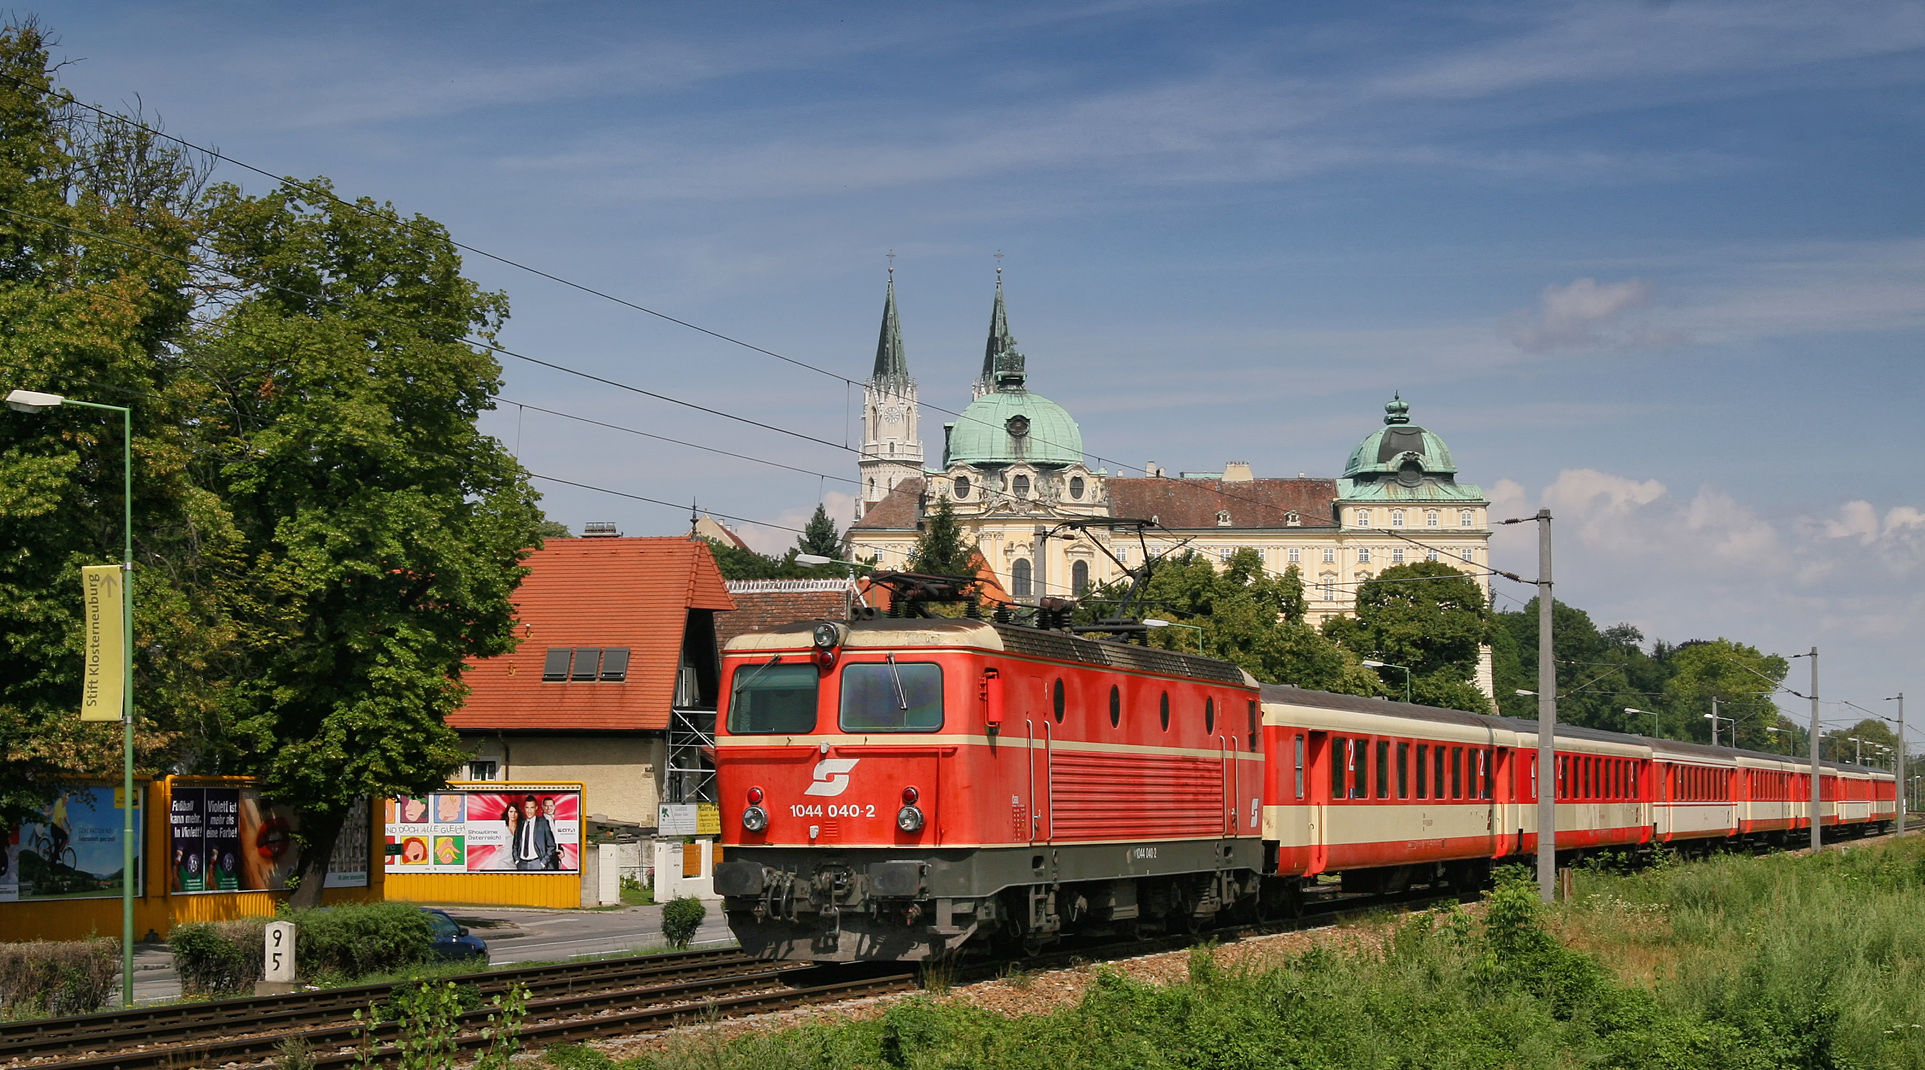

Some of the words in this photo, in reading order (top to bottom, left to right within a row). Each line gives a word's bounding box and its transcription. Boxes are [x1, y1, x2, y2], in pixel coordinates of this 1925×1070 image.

[88, 573, 100, 676] Klosterneuburg
[86, 679, 99, 707] Stift
[1348, 738, 1355, 771] 2
[1479, 749, 1484, 776] 2
[172, 800, 194, 812] Fußball
[208, 800, 228, 812] Violett
[229, 802, 237, 812] ist
[789, 804, 823, 818] 1044
[827, 804, 876, 818] 040-2
[170, 813, 184, 824] kann
[185, 812, 202, 824] mehr.
[210, 814, 225, 825] mehr
[225, 814, 235, 825] als
[181, 826, 202, 838] Violett!
[206, 827, 218, 838] eine
[219, 826, 238, 838] Farbe!
[398, 824, 419, 835] DOCH
[421, 825, 439, 834] ALLE
[440, 825, 466, 834] GLEICH
[273, 929, 282, 947] 9
[273, 953, 282, 971] 5
